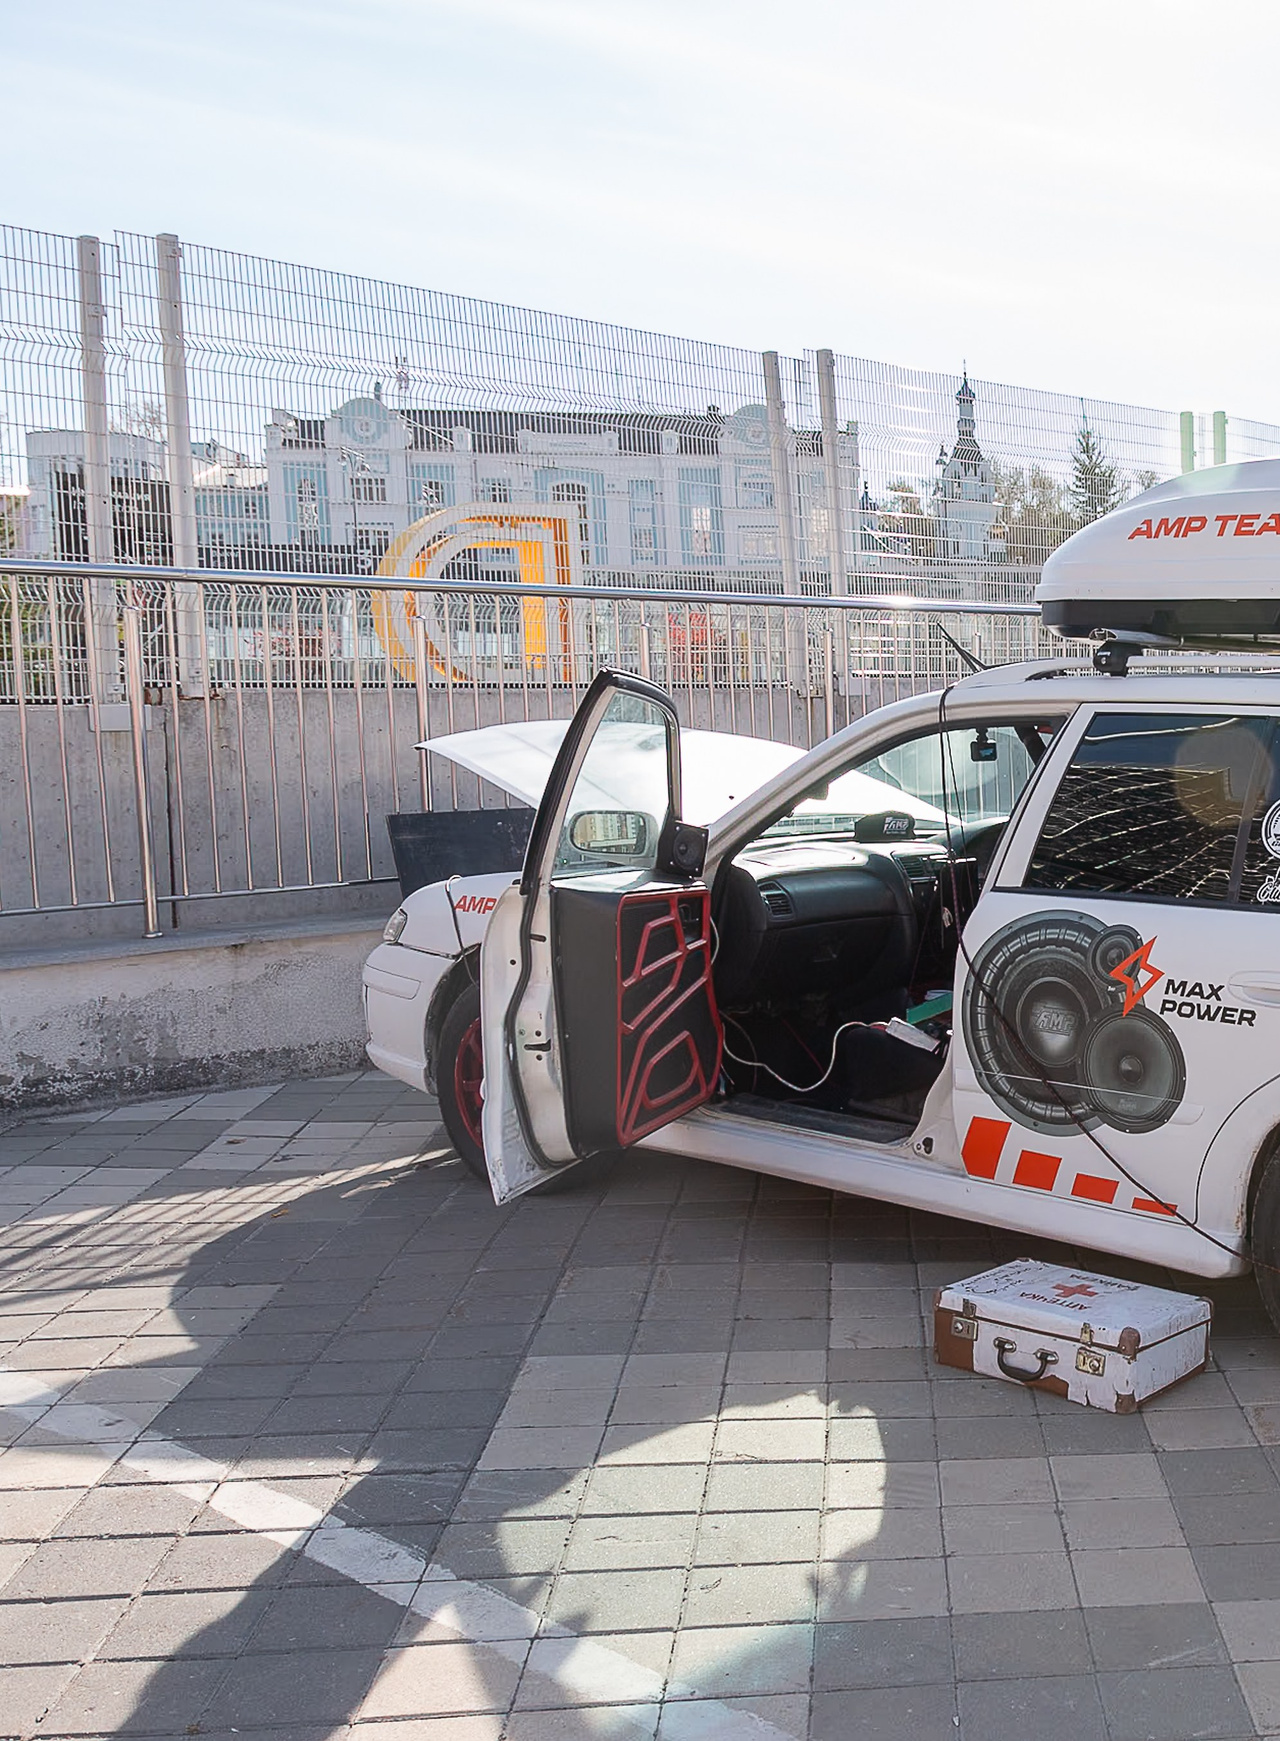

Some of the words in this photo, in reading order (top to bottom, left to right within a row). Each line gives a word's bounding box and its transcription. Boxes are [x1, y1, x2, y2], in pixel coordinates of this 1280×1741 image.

[1128, 515, 1208, 540] AMP
[453, 895, 498, 914] AMP
[1164, 979, 1227, 1002] MAX
[1159, 999, 1257, 1027] POWER
